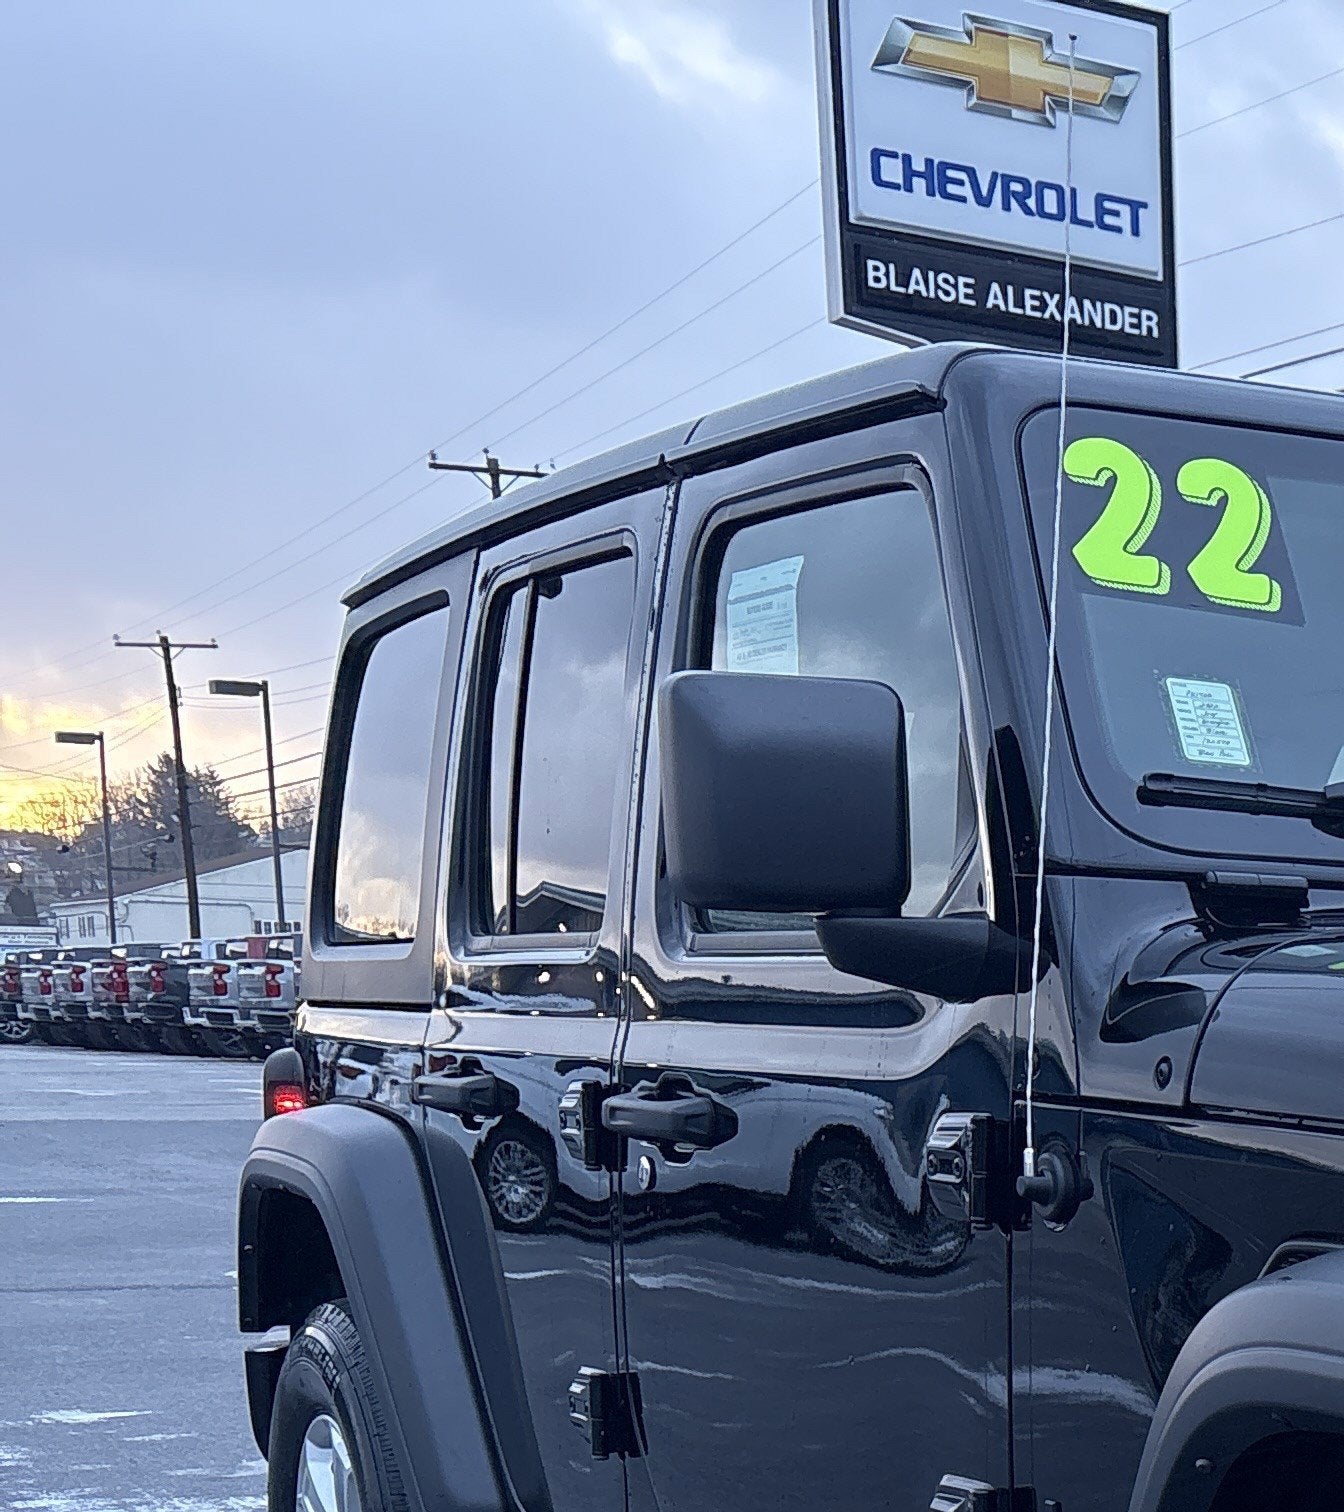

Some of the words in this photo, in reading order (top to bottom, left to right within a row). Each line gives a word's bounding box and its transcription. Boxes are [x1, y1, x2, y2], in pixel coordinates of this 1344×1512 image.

[870, 147, 1149, 238] CHEVROLET
[865, 259, 976, 307] BLAISE
[985, 281, 1160, 339] ALEXANDER
[1063, 437, 1282, 612] 22
